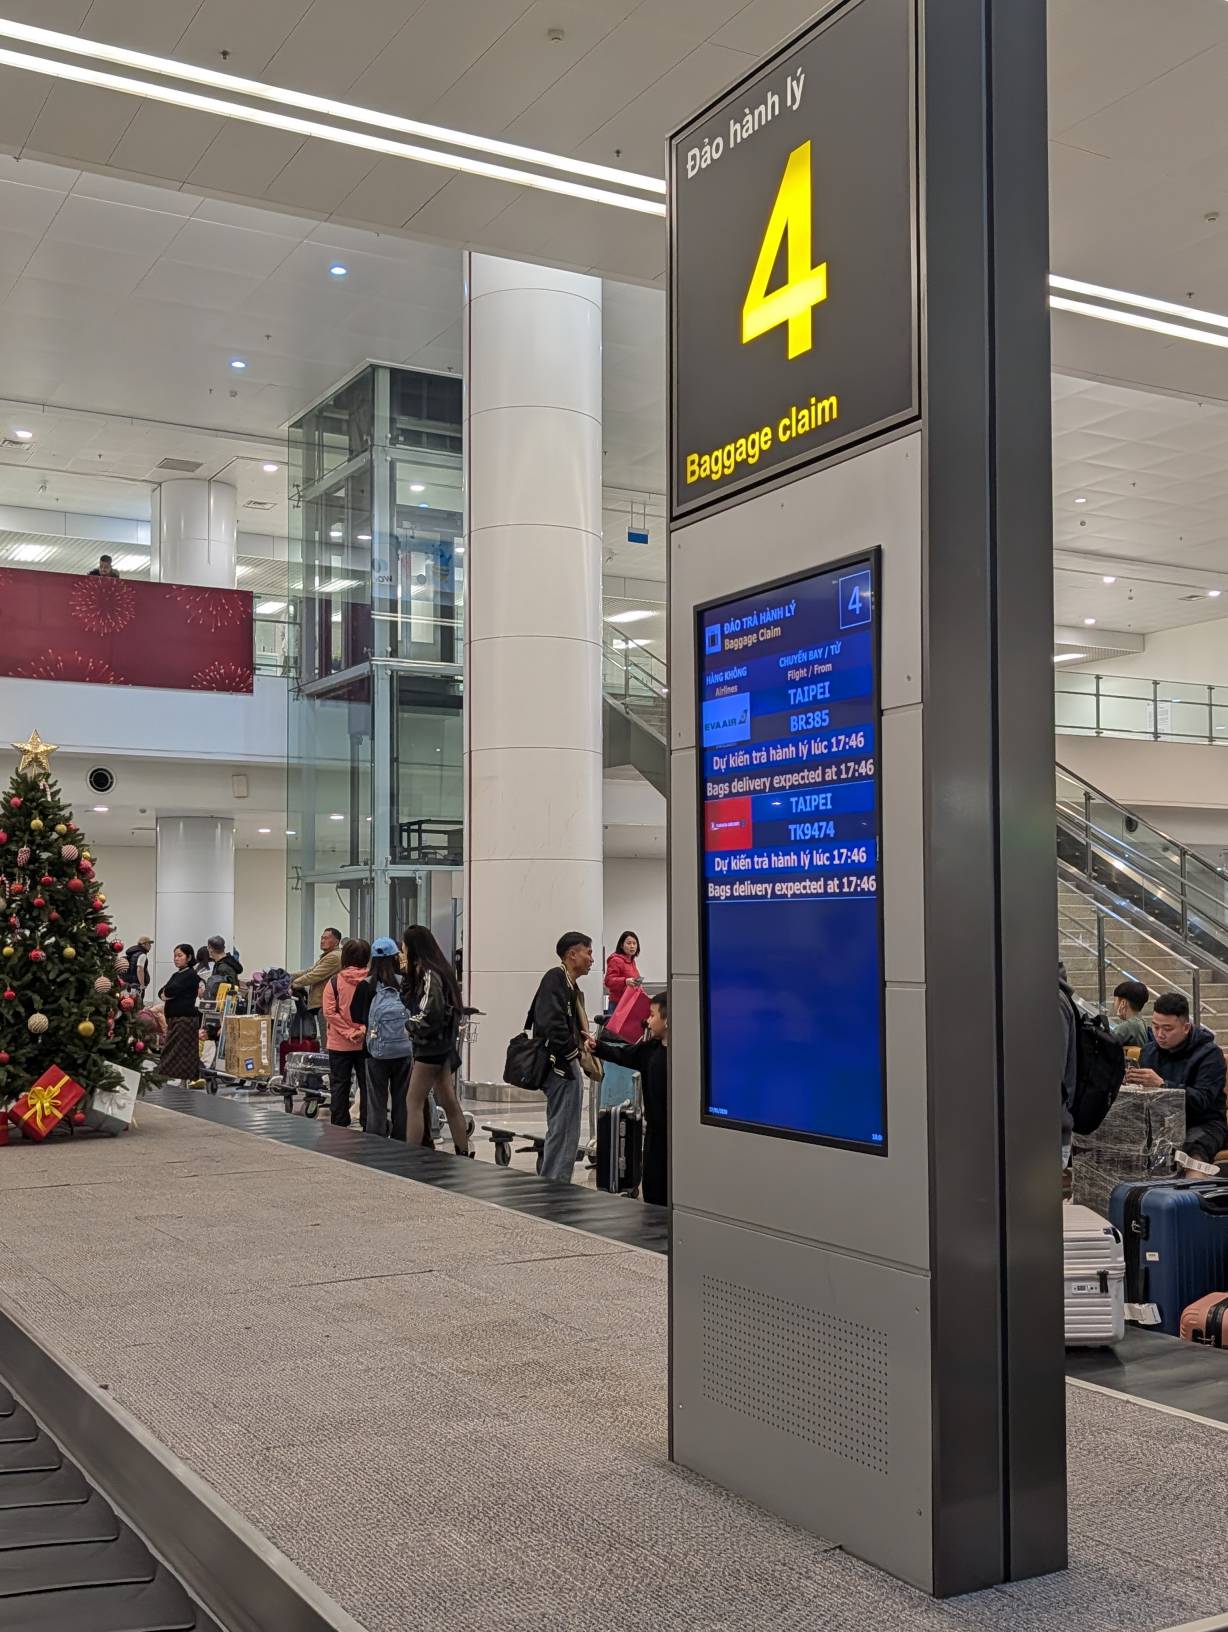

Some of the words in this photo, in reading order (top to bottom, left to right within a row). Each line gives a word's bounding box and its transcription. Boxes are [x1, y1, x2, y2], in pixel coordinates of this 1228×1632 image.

[686, 138, 723, 179] Đảo
[730, 91, 779, 148] hành
[787, 67, 805, 110] lý
[741, 139, 827, 360] 4
[686, 426, 772, 484] Baggage
[778, 396, 837, 442] claim
[848, 586, 862, 614] 4
[724, 618, 740, 634] ĐẢO
[742, 610, 759, 629] TRẢ
[760, 607, 784, 624] HÀNH
[785, 600, 796, 616] LÝ
[724, 632, 758, 650] Baggage
[759, 626, 781, 641] Claim
[809, 648, 823, 660] BAY
[787, 668, 807, 681] Flight
[814, 663, 832, 675] From
[715, 685, 738, 696] Airlines
[789, 681, 830, 705] TAIPEI
[790, 710, 830, 732] BR385
[713, 755, 728, 772] Dự
[729, 751, 750, 768] kiến
[752, 748, 766, 764] trả
[770, 744, 796, 761] hành
[799, 741, 809, 760] lý
[811, 738, 828, 755] lúc
[831, 732, 864, 752] 17:46
[706, 782, 729, 798] Bags
[731, 776, 771, 793] delivery
[773, 766, 822, 789] expected
[825, 767, 837, 781] at
[840, 759, 874, 779] 17:46
[791, 793, 832, 813] TAIPEI
[789, 821, 835, 840] TK9474
[715, 857, 728, 874] Dự
[731, 855, 752, 870] kiến
[754, 854, 768, 869] trả
[771, 851, 798, 868] hành
[800, 850, 811, 869] lý
[813, 850, 830, 865] lúc
[833, 847, 866, 865] 17:46
[708, 883, 730, 899] Bags
[733, 880, 772, 898] delivery
[775, 878, 824, 898] expected
[827, 880, 839, 892] at
[842, 875, 876, 892] 17:46
